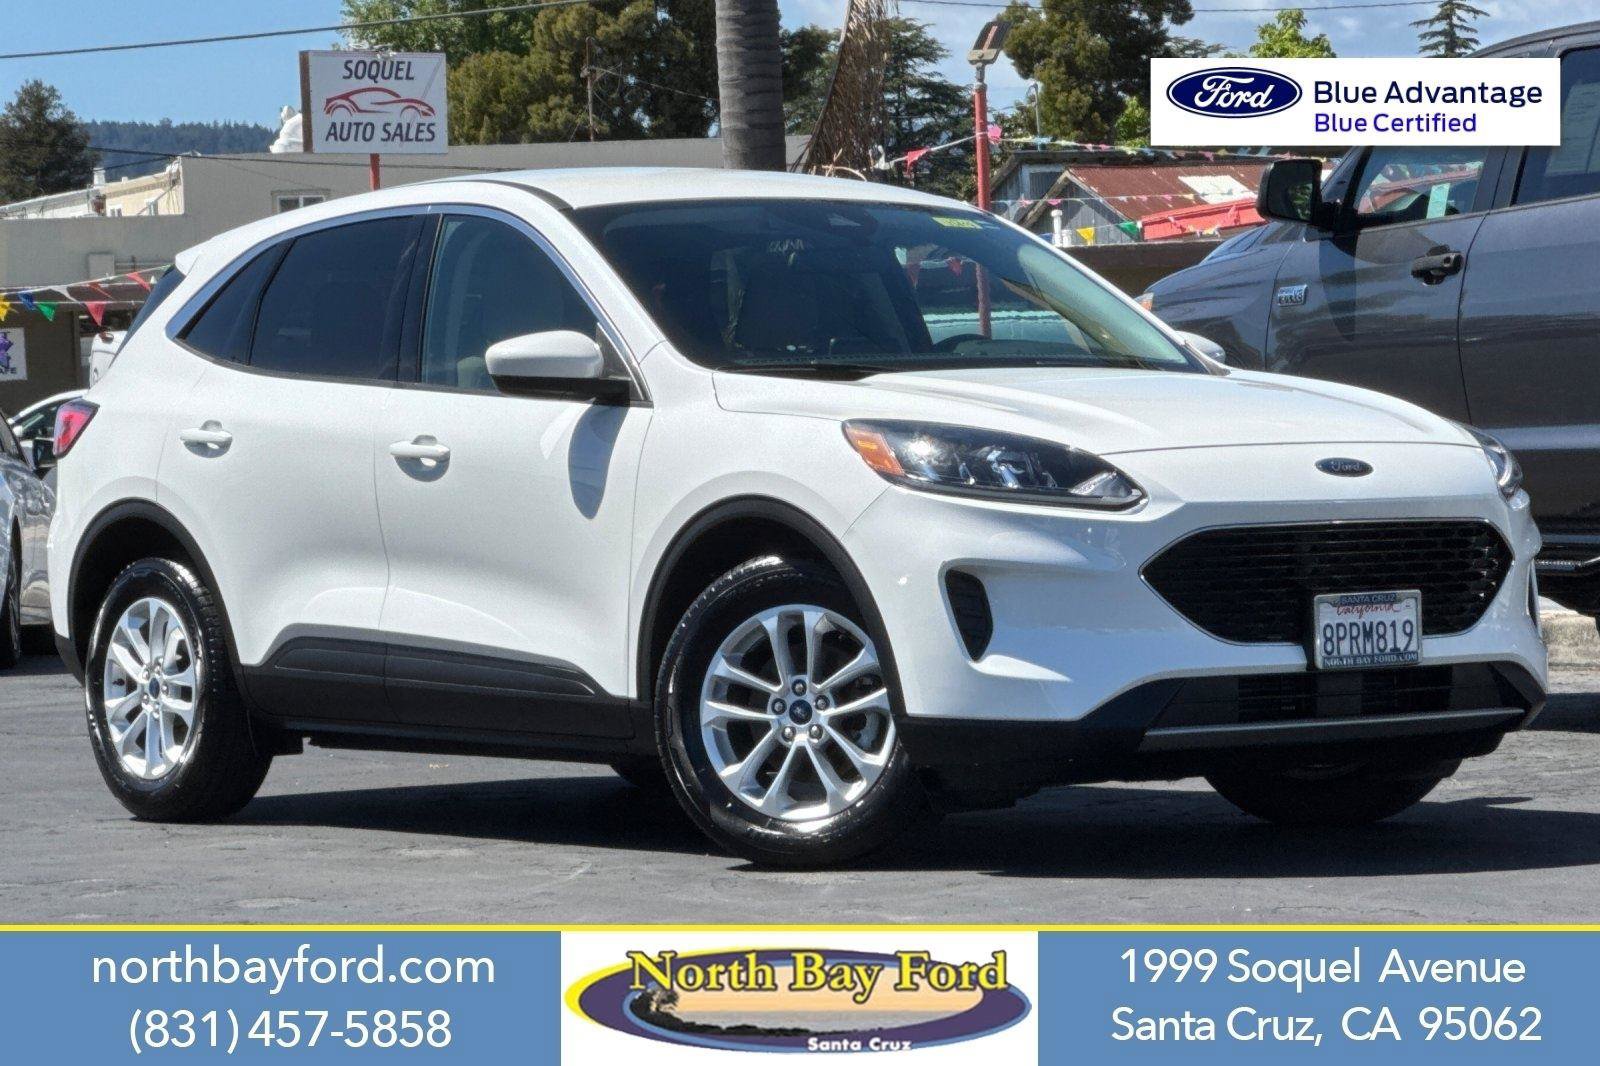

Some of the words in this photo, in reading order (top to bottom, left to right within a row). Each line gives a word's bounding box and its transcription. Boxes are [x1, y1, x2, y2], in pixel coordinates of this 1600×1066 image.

[342, 60, 415, 83] SOQUEL
[325, 122, 375, 142] AUTO
[380, 122, 436, 142] SALES
[1341, 595, 1370, 604] SANTA
[1372, 594, 1396, 602] CRUZ
[1336, 603, 1401, 619] California
[1323, 619, 1414, 656] 8PRM819
[1324, 657, 1354, 666] NORTH
